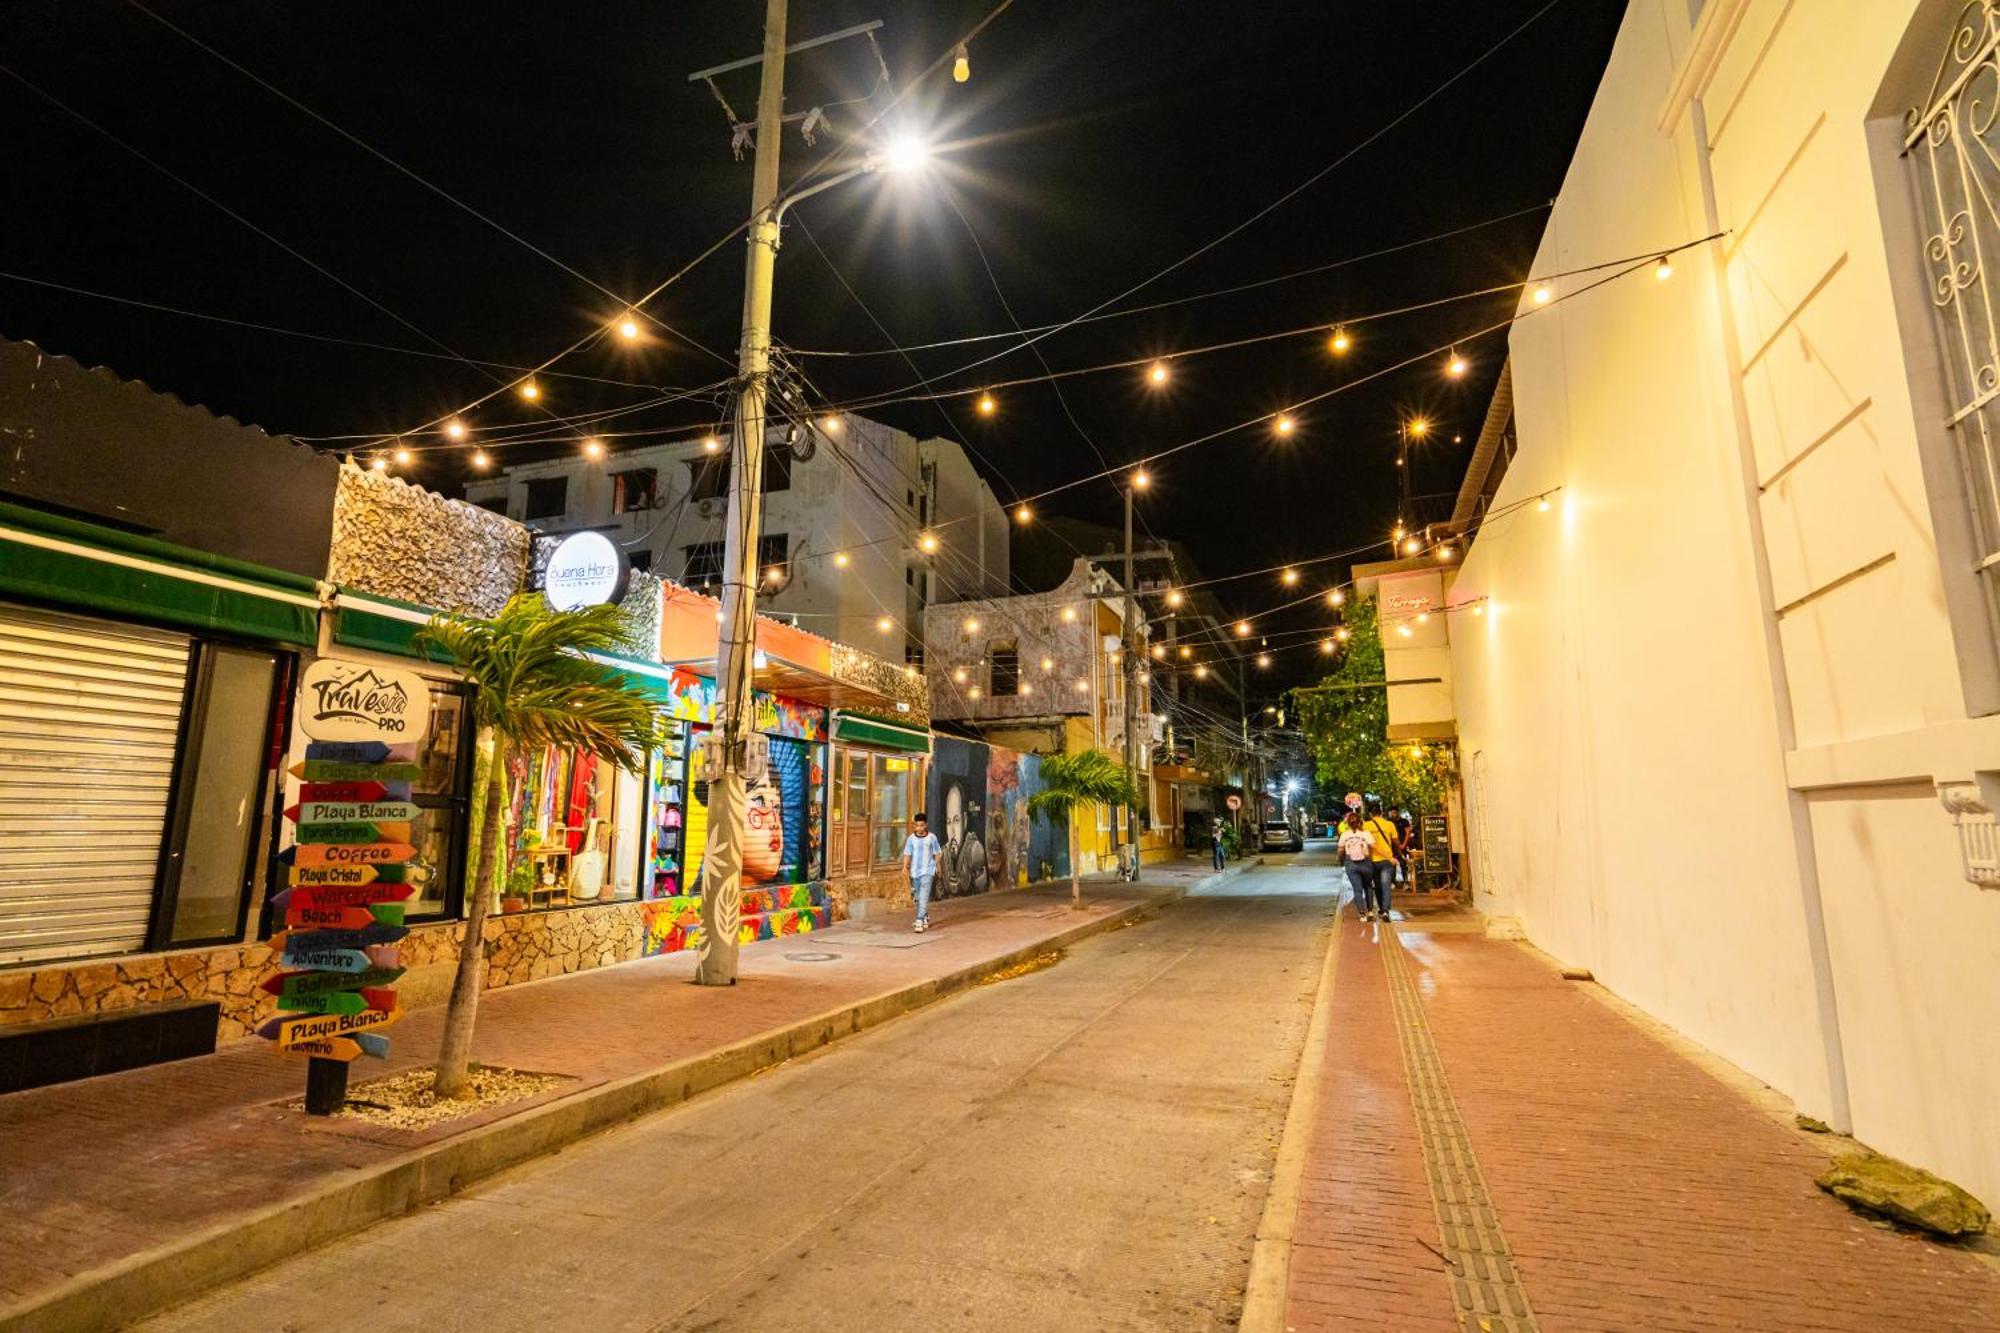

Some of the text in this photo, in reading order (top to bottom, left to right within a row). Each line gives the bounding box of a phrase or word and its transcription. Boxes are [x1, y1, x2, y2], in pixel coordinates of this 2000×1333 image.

[550, 561, 614, 579] Buena Hora
[379, 717, 405, 732] PRO
[313, 804, 407, 820] Playa Blanca
[325, 847, 391, 862] Coffee
[299, 868, 362, 883] Playa Cristal
[302, 909, 342, 923] Beach
[290, 1009, 389, 1041] Playa Blanca
